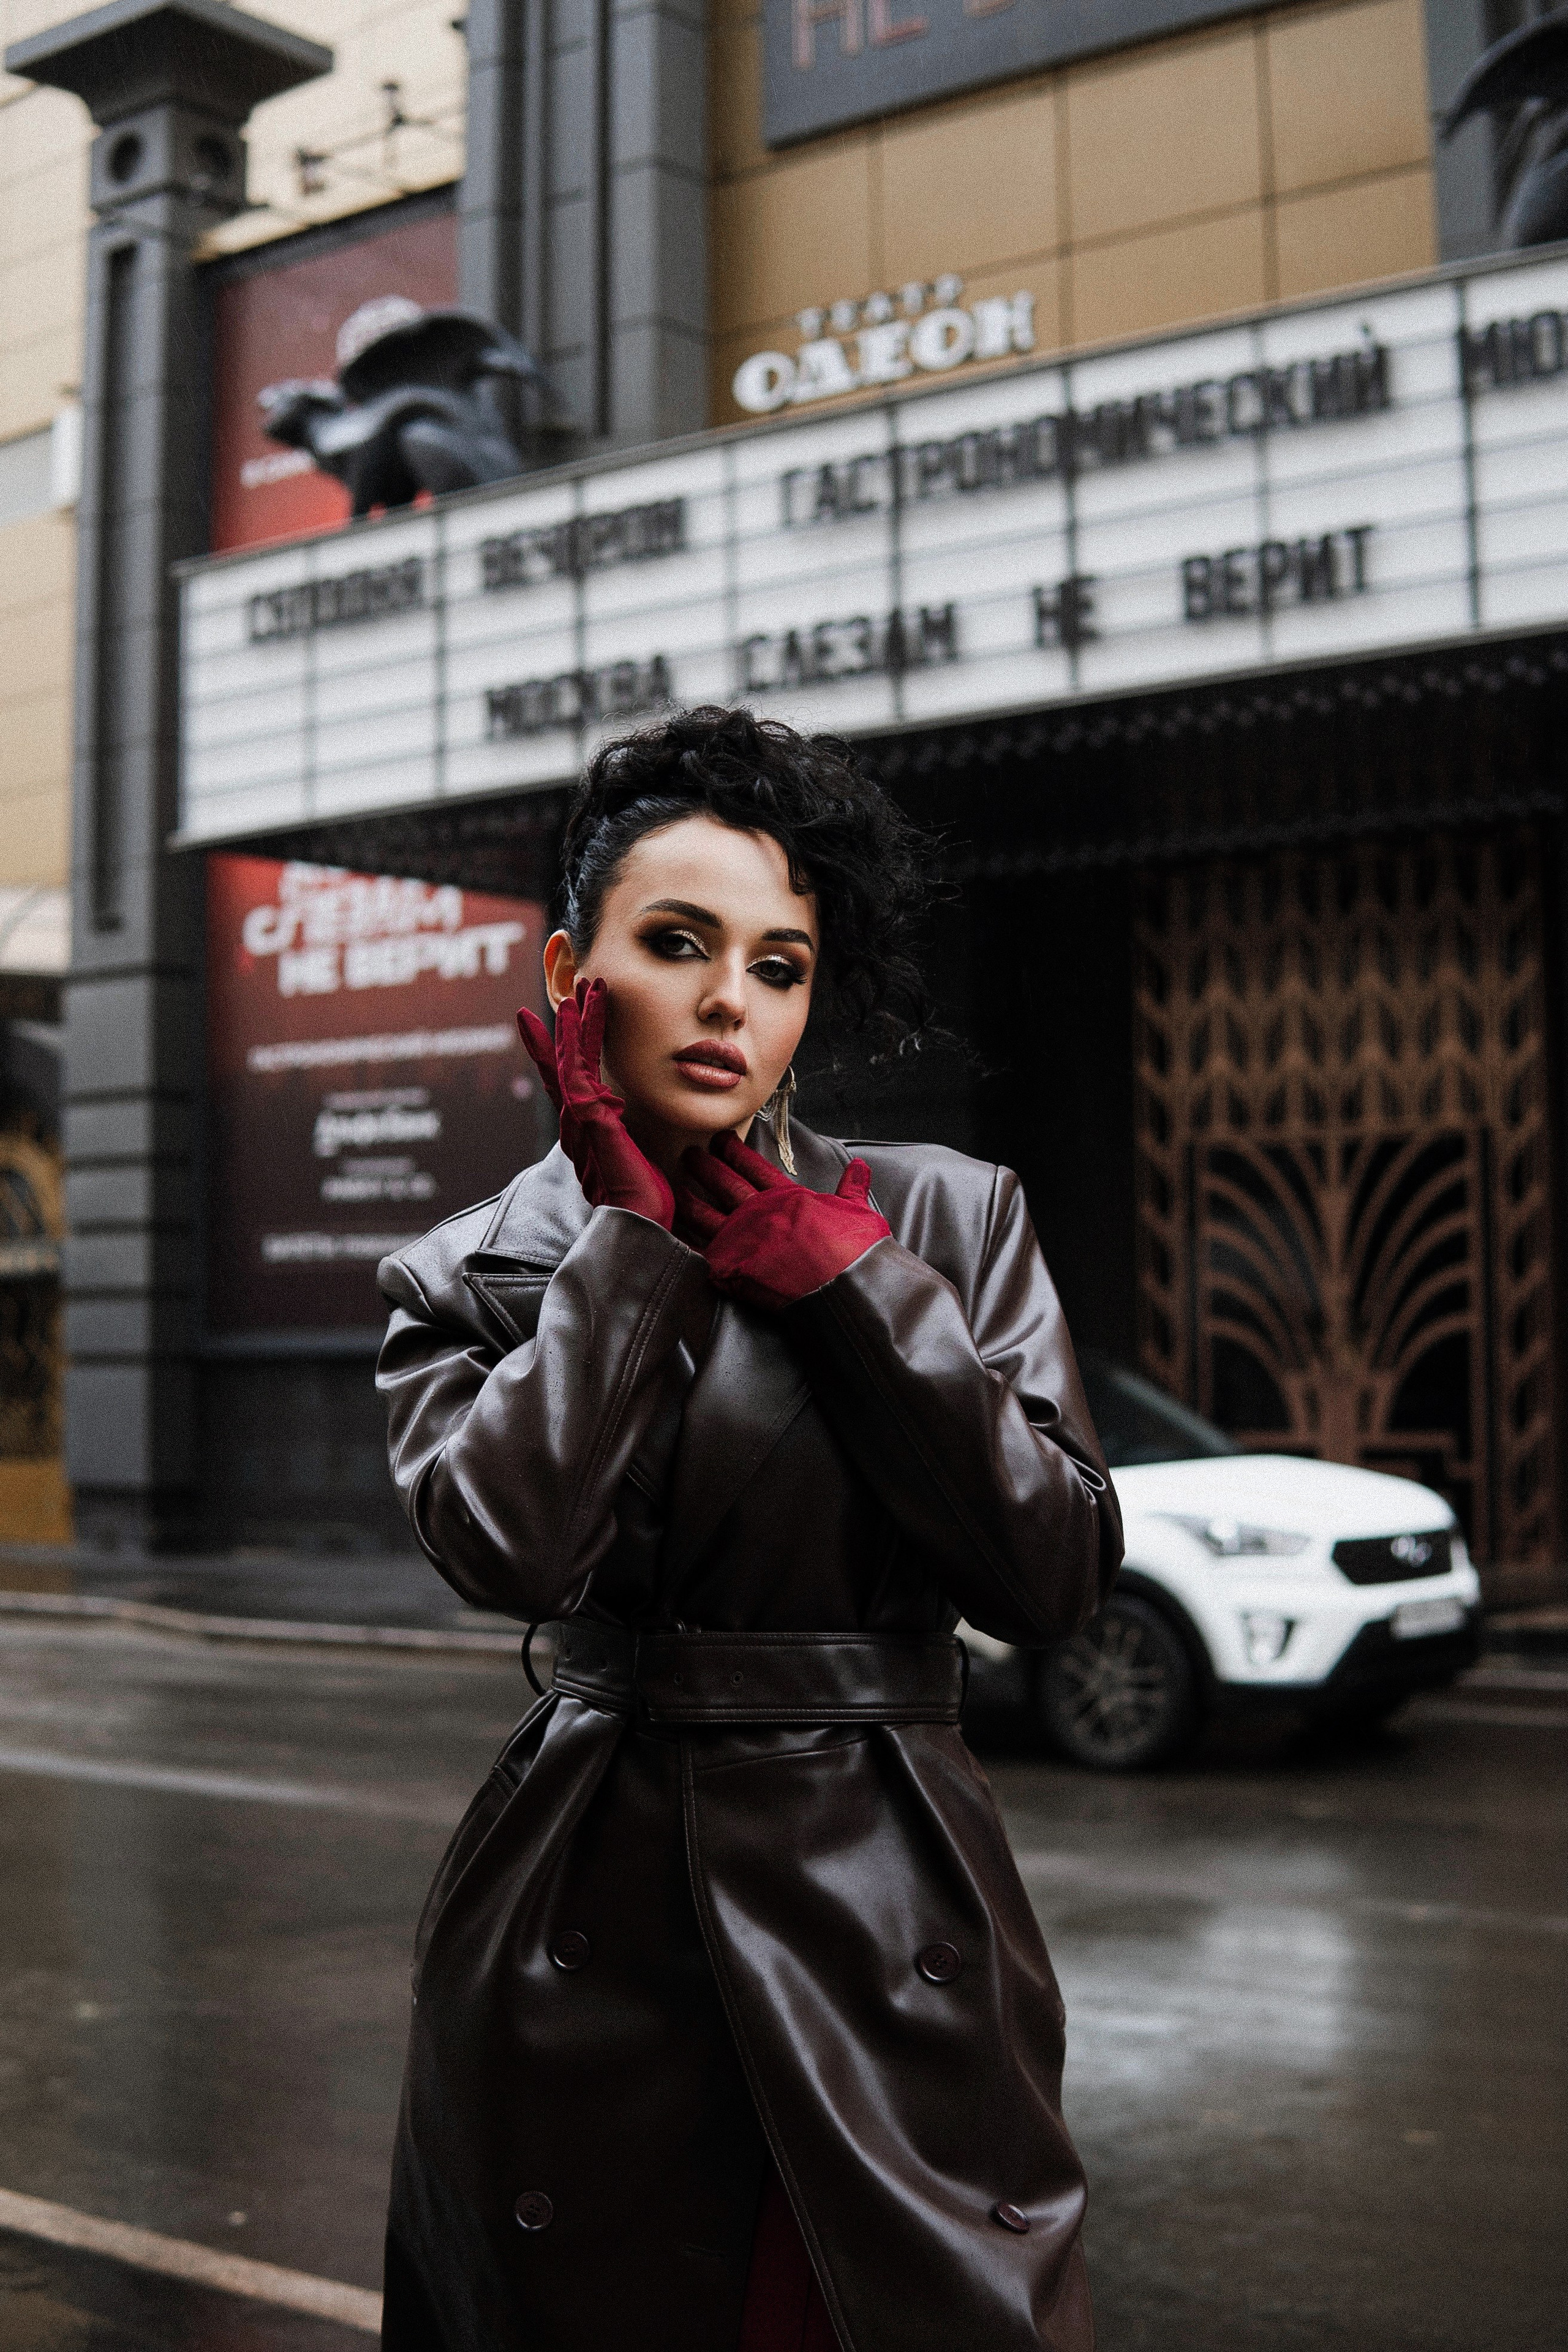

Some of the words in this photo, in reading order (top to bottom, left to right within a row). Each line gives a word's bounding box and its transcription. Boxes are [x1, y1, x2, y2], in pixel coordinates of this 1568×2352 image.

[733, 290, 1035, 413] ОДЕОН
[782, 323, 1390, 527] ГАСТРОНОМИЧЕСКИЙ
[488, 653, 672, 742] МОСКВА
[743, 603, 959, 692] СЛЕЗАМ
[1031, 575, 1098, 650] НЕ
[1182, 526, 1375, 621] ВЕРИТ
[344, 921, 526, 990] ВЕРИТ
